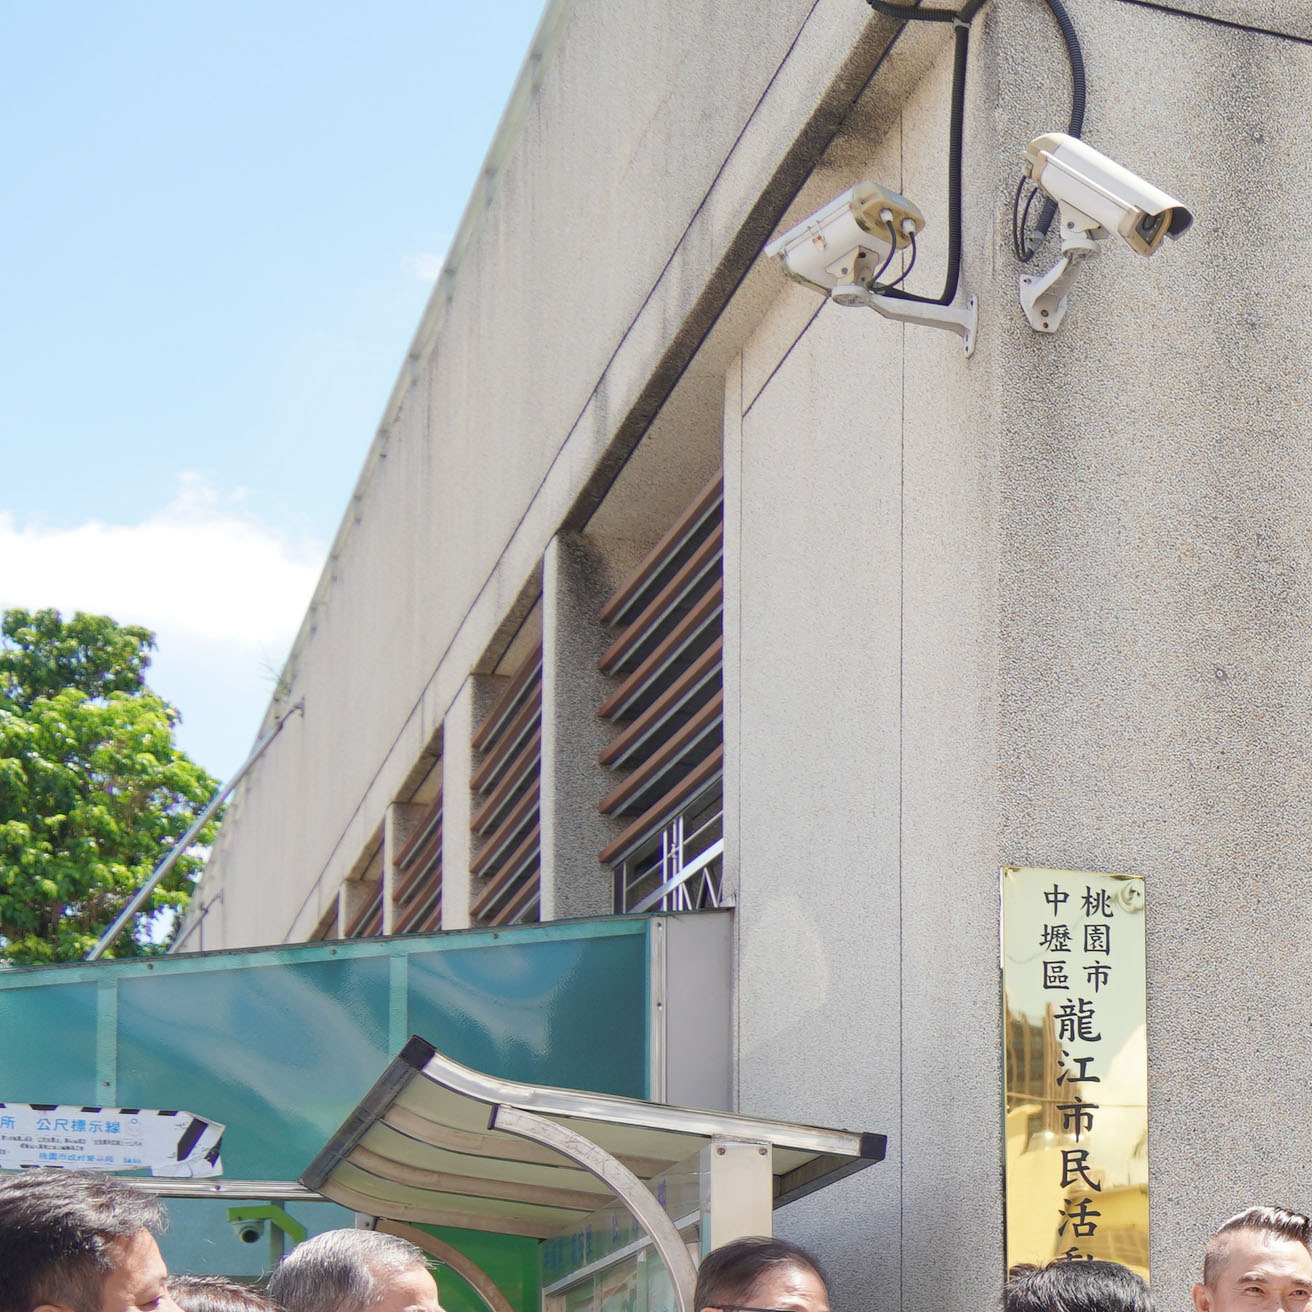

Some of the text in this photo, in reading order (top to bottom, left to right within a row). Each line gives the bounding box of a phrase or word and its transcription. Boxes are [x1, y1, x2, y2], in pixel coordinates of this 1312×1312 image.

[1040, 883, 1072, 991] 中壢區
[1081, 885, 1114, 994] 桃園市
